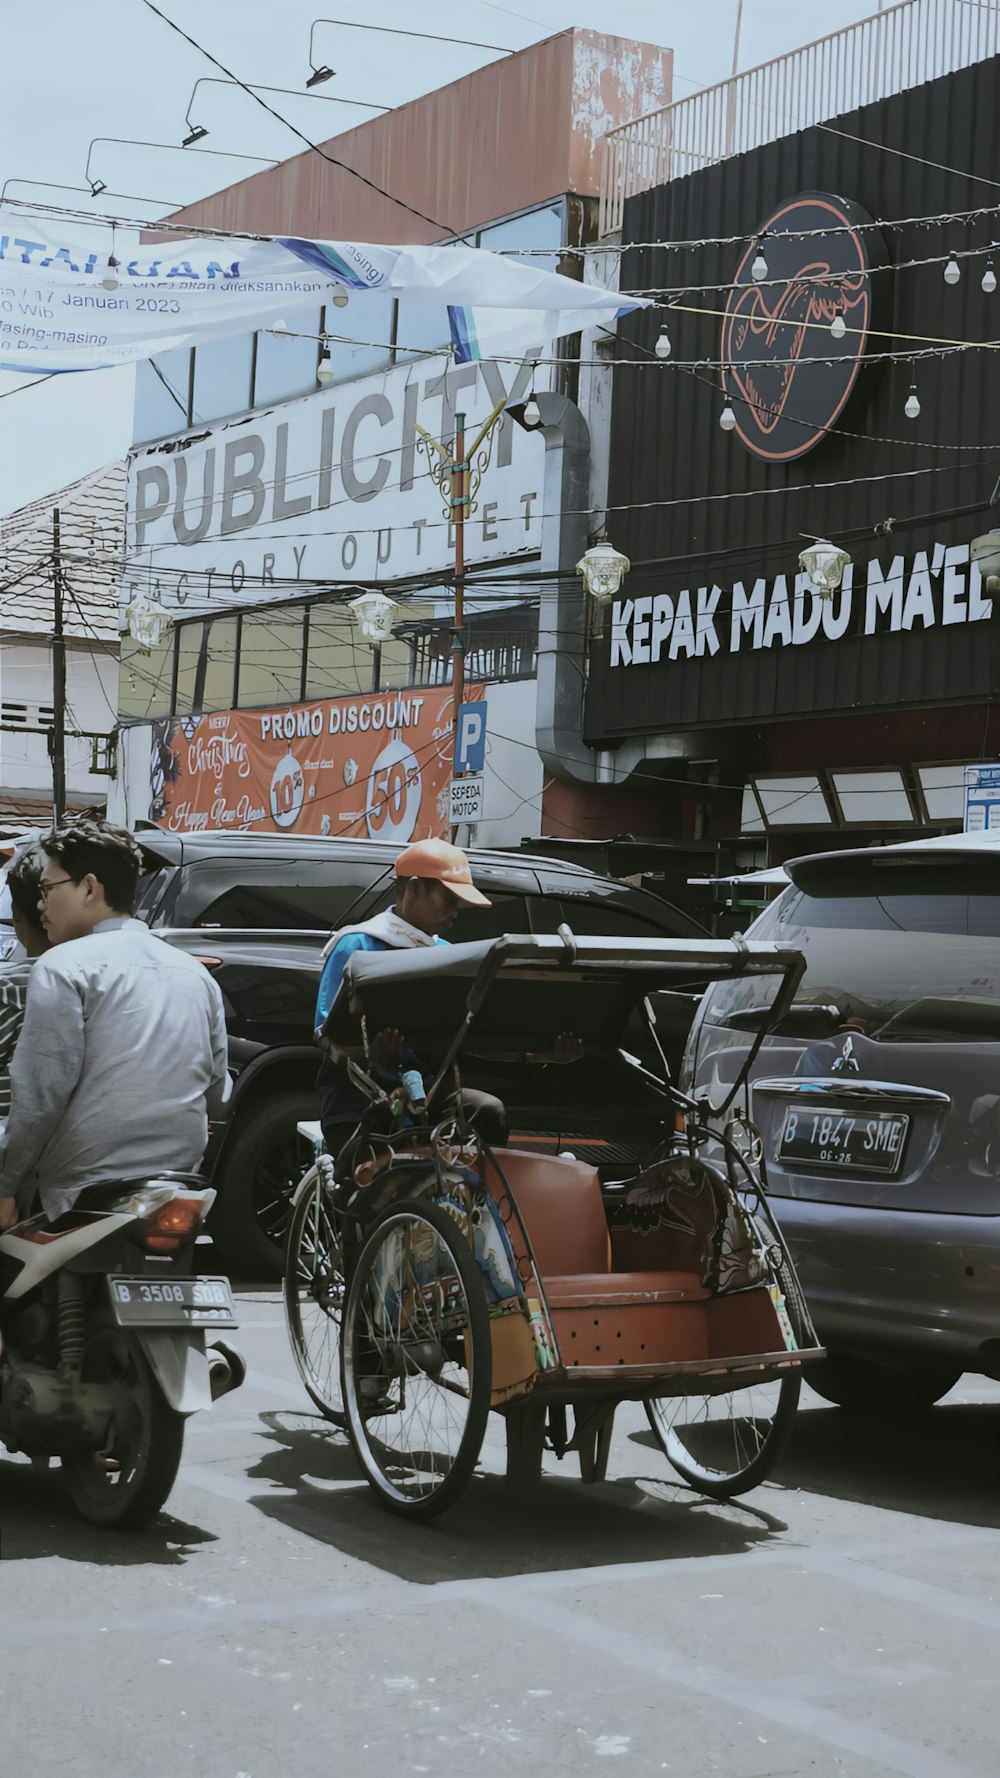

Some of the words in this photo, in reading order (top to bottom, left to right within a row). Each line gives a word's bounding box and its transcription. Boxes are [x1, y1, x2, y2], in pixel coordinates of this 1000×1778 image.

[344, 243, 385, 285] asing)
[19, 303, 55, 320] Wib
[62, 293, 129, 311] Januari
[135, 298, 181, 314] 2023
[0, 321, 108, 347] asing-masing
[135, 345, 544, 550] PUBLICITY
[610, 584, 722, 667] KEPAK
[730, 563, 855, 653] MADU
[864, 542, 993, 636] MA'EL
[260, 708, 323, 741] PROMO
[329, 697, 424, 735] DISCOUNT
[460, 712, 482, 763] P
[369, 762, 419, 832] 50%
[451, 785, 481, 800] SEPEDA
[168, 801, 209, 832] Happy
[452, 802, 479, 817] MOTOR
[784, 1114, 799, 1143] B
[810, 1115, 856, 1148] 1847
[117, 1285, 131, 1303] B
